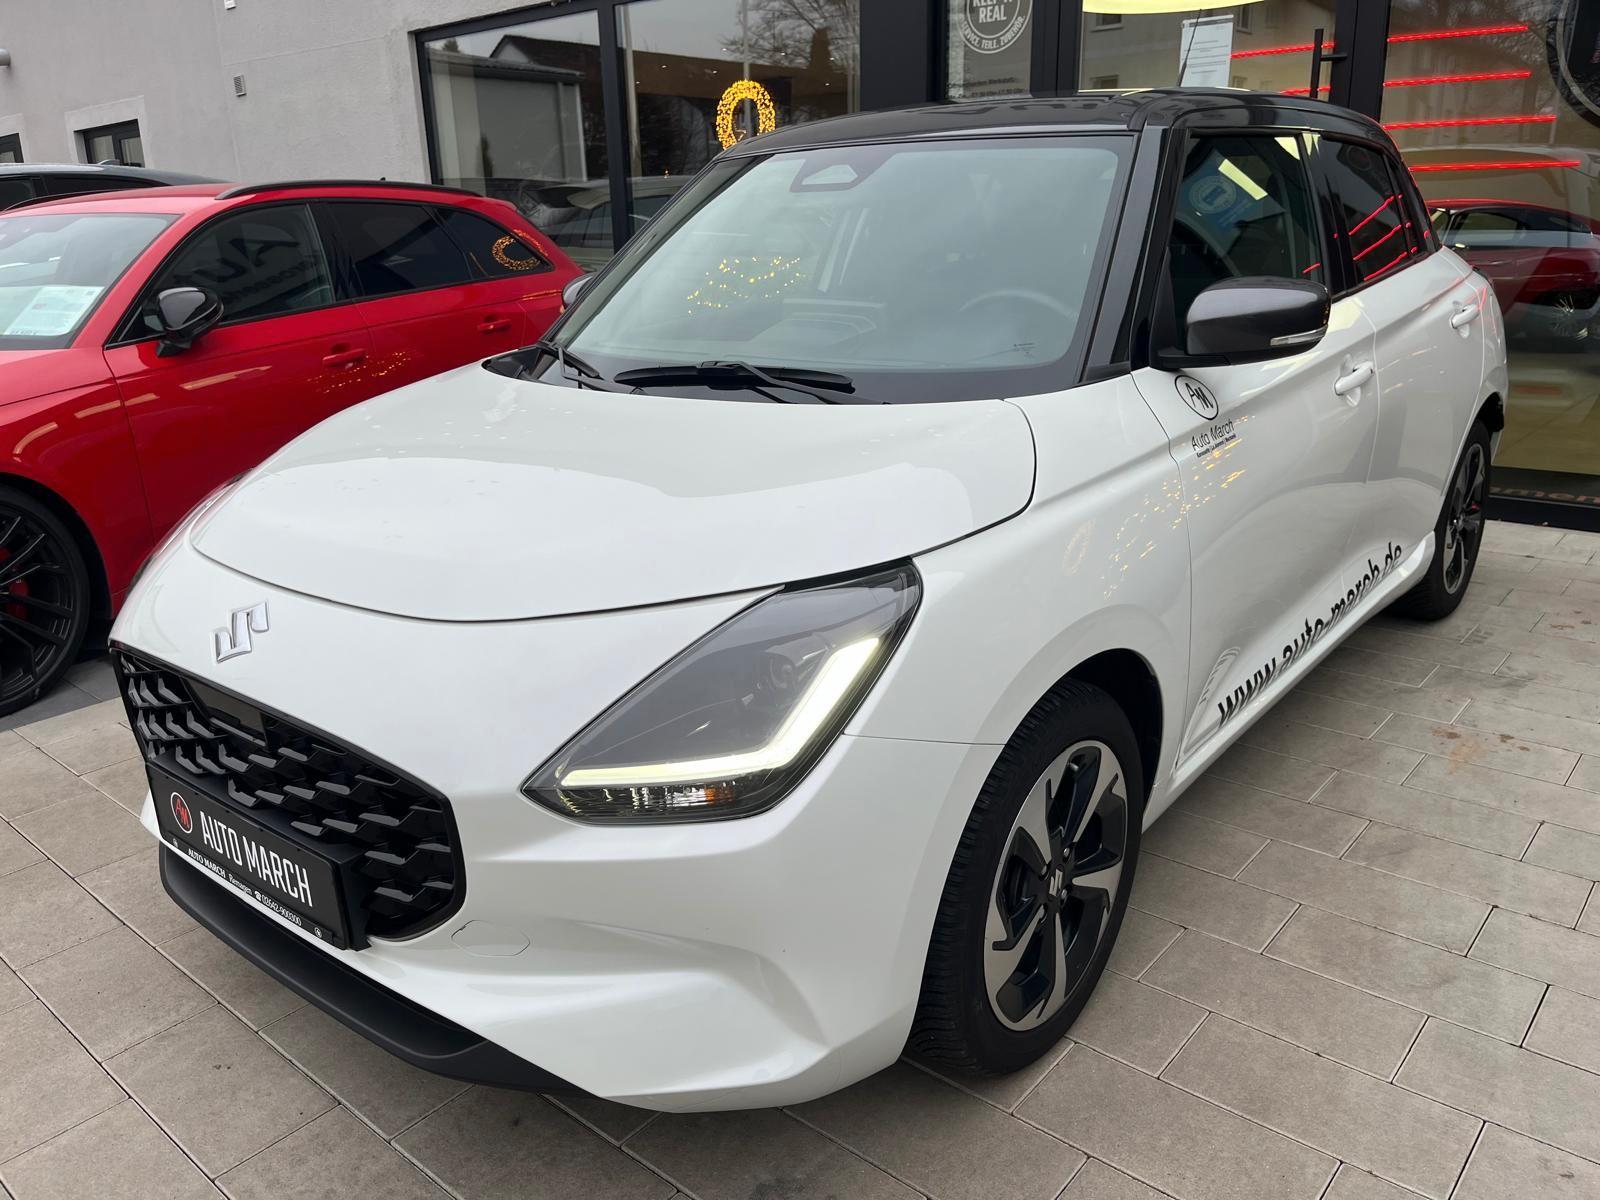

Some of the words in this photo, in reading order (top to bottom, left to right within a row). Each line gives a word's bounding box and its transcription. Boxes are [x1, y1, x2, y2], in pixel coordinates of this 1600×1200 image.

[979, 4, 1007, 23] REAL
[1191, 435, 1211, 452] Auto
[1210, 418, 1235, 441] March
[188, 848, 205, 864] AUTO
[204, 858, 226, 879] MARCH
[199, 810, 242, 866] AUTO
[242, 835, 313, 908] MARCH
